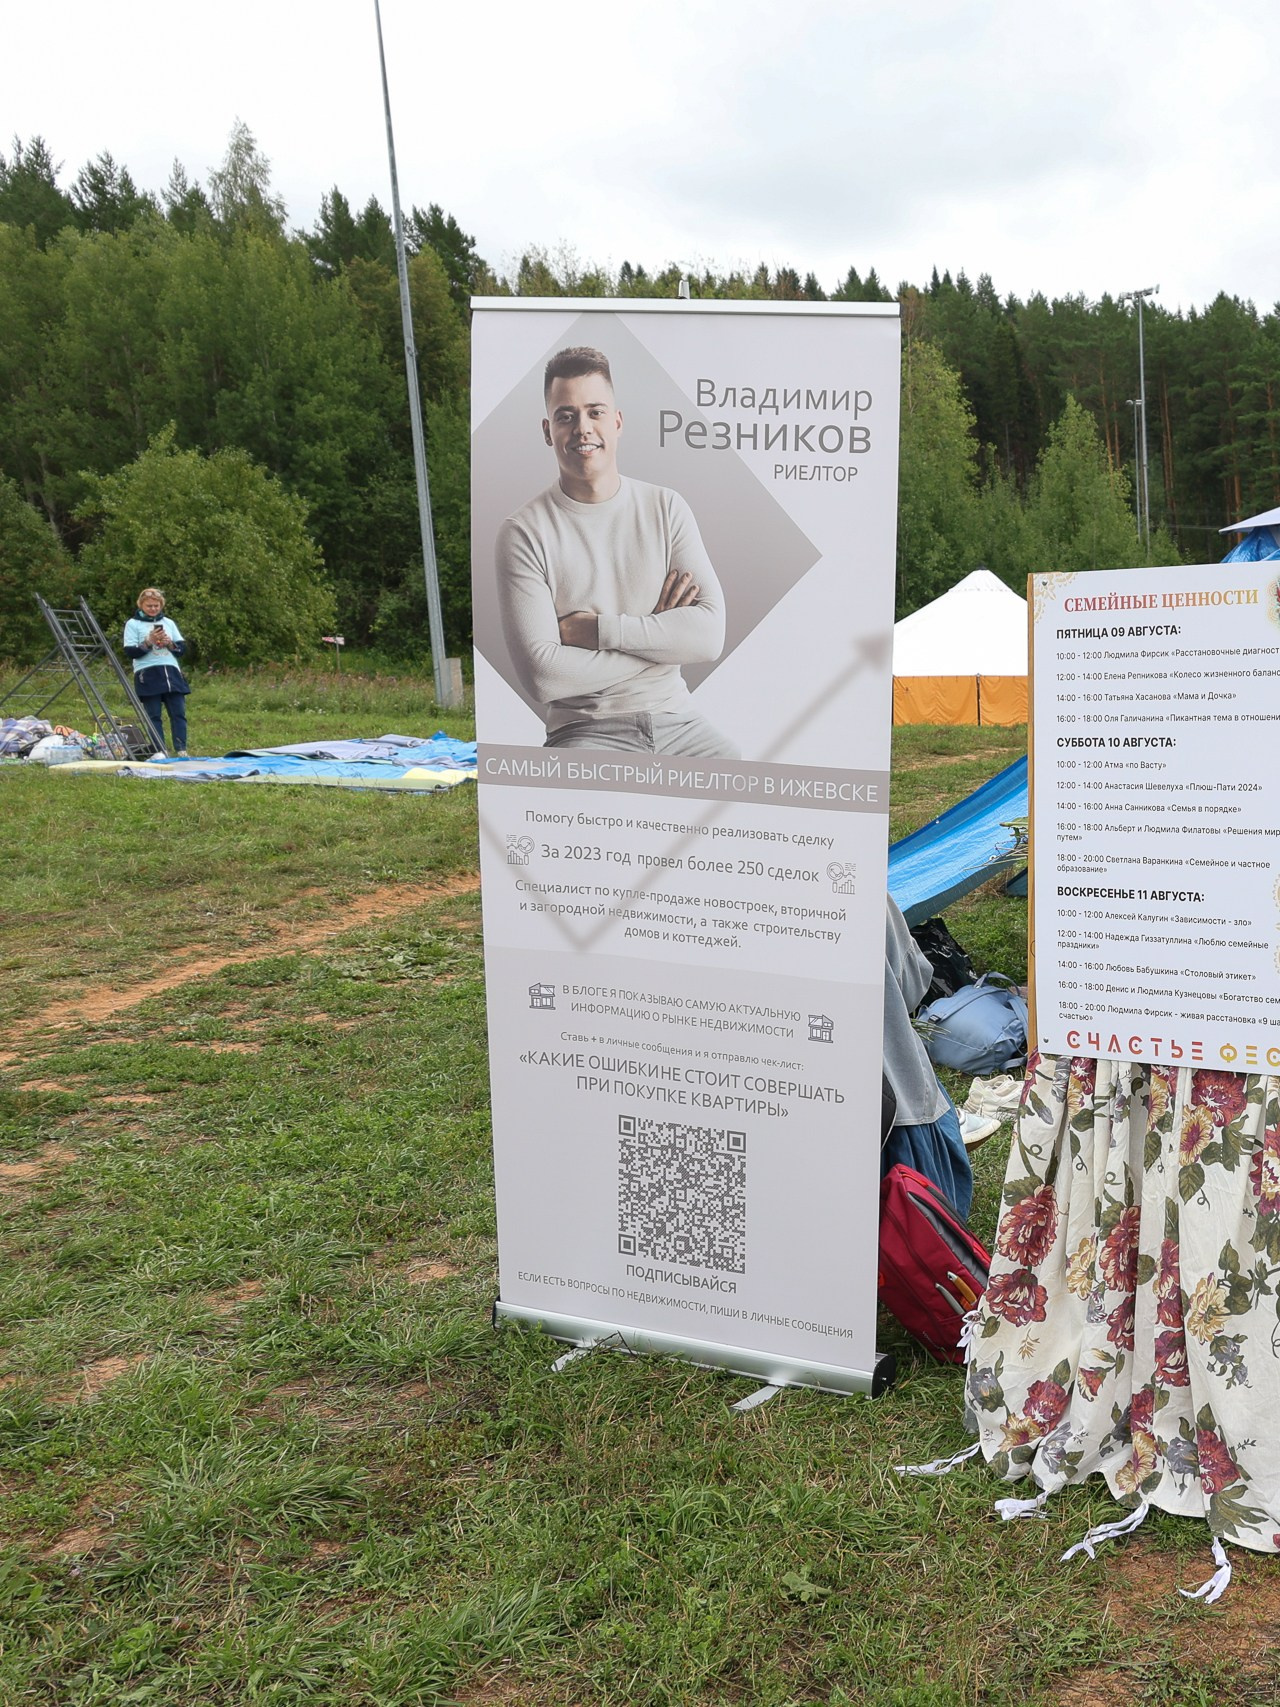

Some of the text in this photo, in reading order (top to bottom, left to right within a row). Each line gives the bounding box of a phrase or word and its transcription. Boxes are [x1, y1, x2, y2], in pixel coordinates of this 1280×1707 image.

[697, 378, 872, 421] Владимир
[660, 410, 871, 454] Резников
[774, 464, 858, 482] РИЕЛТОР
[485, 756, 879, 803] САМЫЙ БЫСТРЫЙ РИЕЛТОР ИЖЕВСКЕ
[525, 810, 834, 850] Помогу быстро качественно реализовать сделку
[541, 844, 819, 882] За 2023 год провел более 250 сделок
[515, 879, 846, 921] Специалист купле-продаже новостроек, вторичной
[530, 898, 842, 943] загородной недвижимости, также строительству
[624, 927, 741, 948] домов коттеджей.
[571, 1002, 794, 1038] ИНФОРМАЦИЮ РЫНКЕ НЕДВИЖИМОСТИ
[572, 985, 801, 1022] БЛОГЕ ПОКАЗЫВАЮ САМУЮ АКТУАЛЬНУЮ
[560, 1031, 804, 1071] Ставь личные сообщения отправлю чек-лист:
[1066, 1030, 1203, 1061] СЧАСТЬЕ
[577, 1075, 789, 1117] ПРИ ПОКУПКЕ КВАРТИРЫ»
[588, 1055, 659, 1079] ОШИБКИ
[685, 1069, 741, 1089] СТОИТ
[744, 1076, 845, 1104] СОВЕРШАТЬ
[626, 1264, 737, 1294] ПОДПИСЫВАЙСЯ
[518, 1271, 853, 1339] ЕСЛИ ЕСТЬ ВОПРОСЫ НЕДВИЖИМОСТИ, ПИШИ ЛИЧНЫЕ СООБЩЕНИЯ
